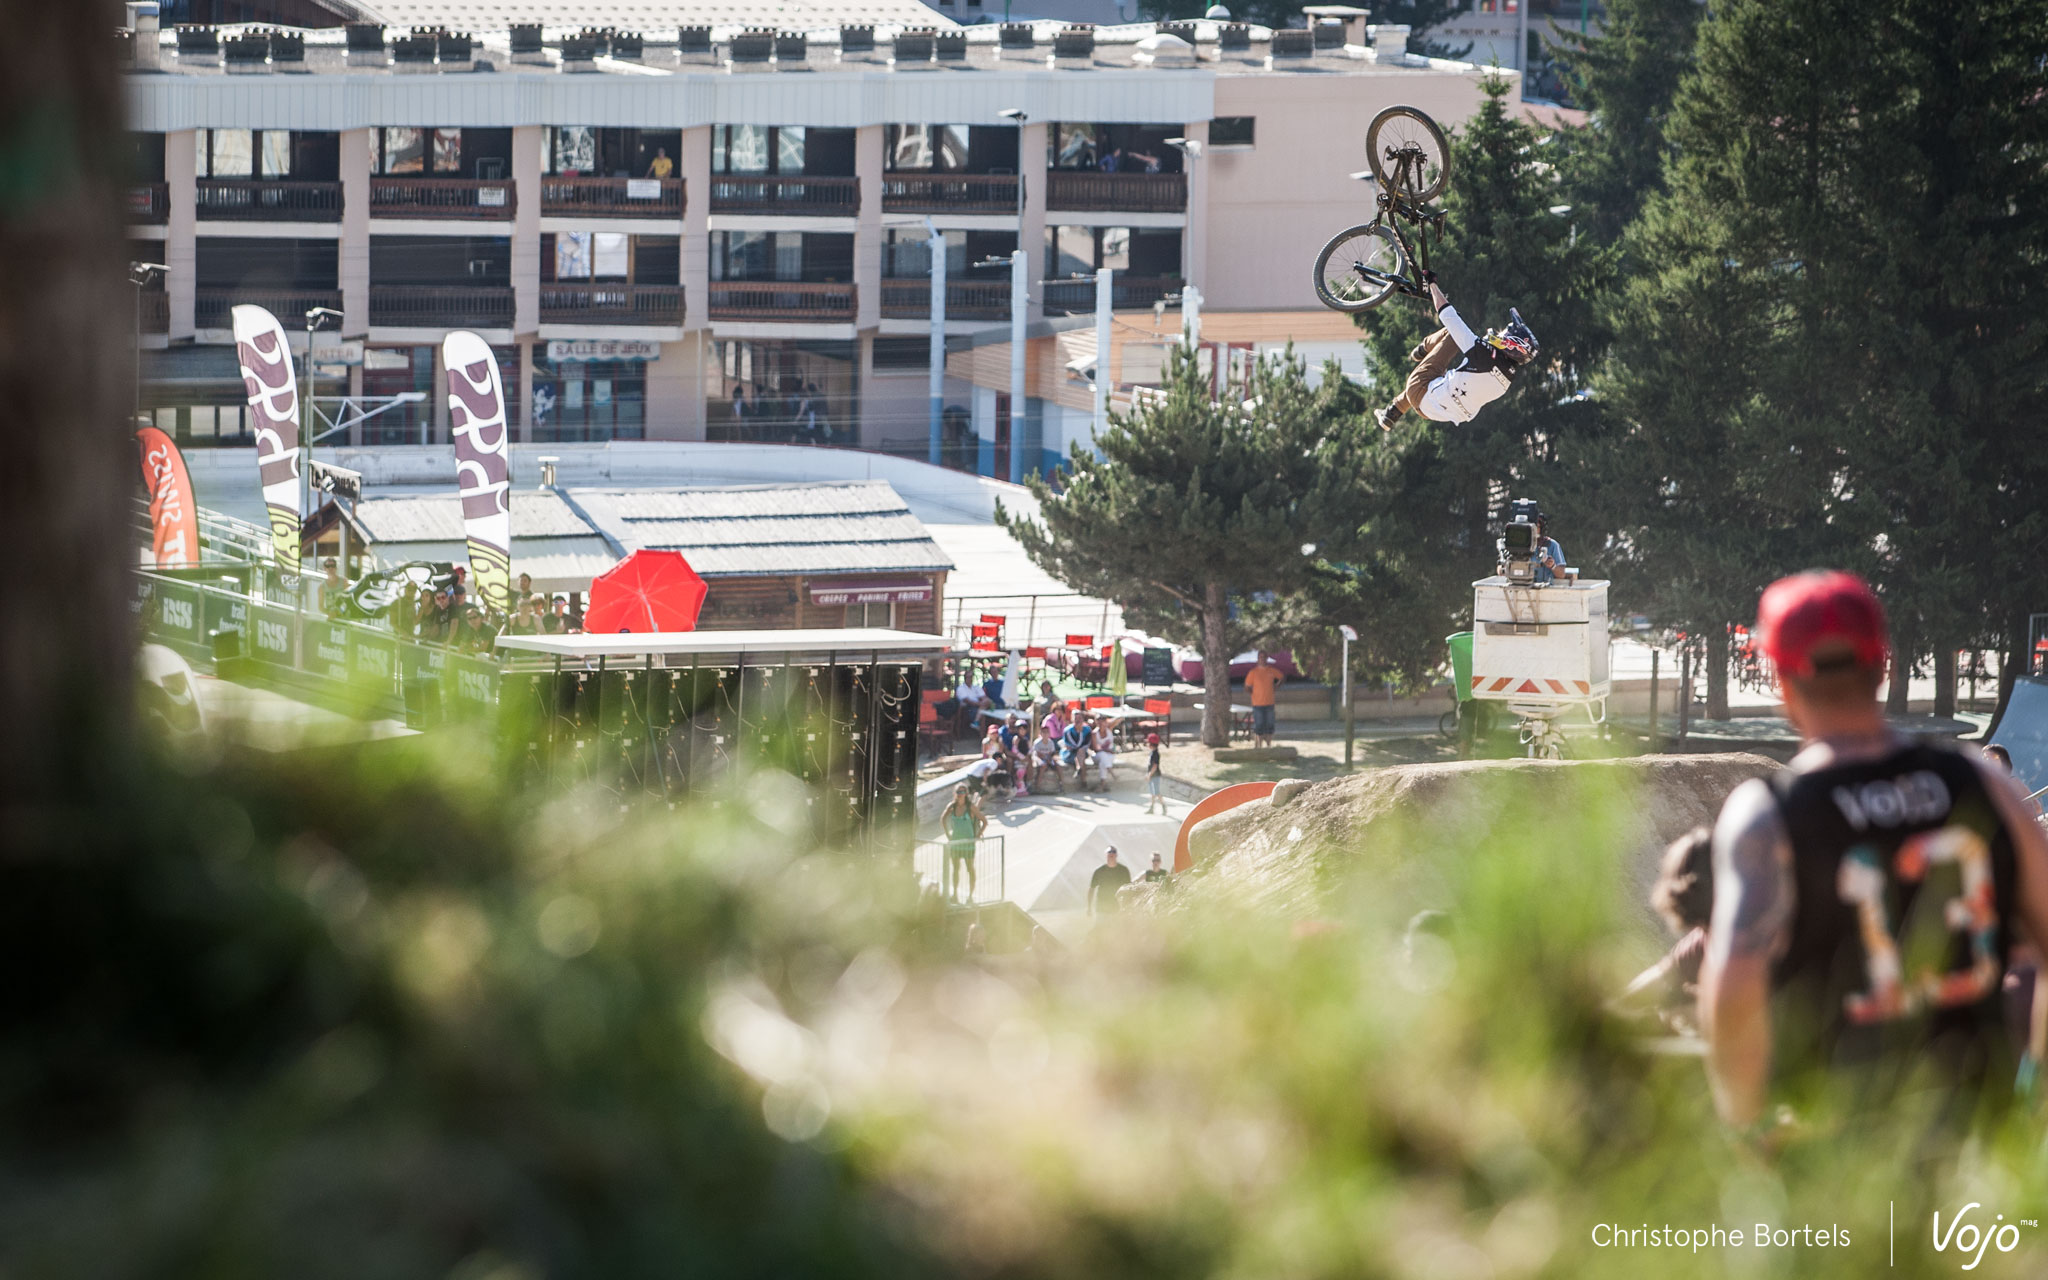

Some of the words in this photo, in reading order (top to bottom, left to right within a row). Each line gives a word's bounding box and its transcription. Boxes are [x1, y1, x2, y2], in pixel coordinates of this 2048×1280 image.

[556, 343, 598, 355] SALLE
[601, 343, 617, 354] DE
[620, 342, 652, 354] JEUX
